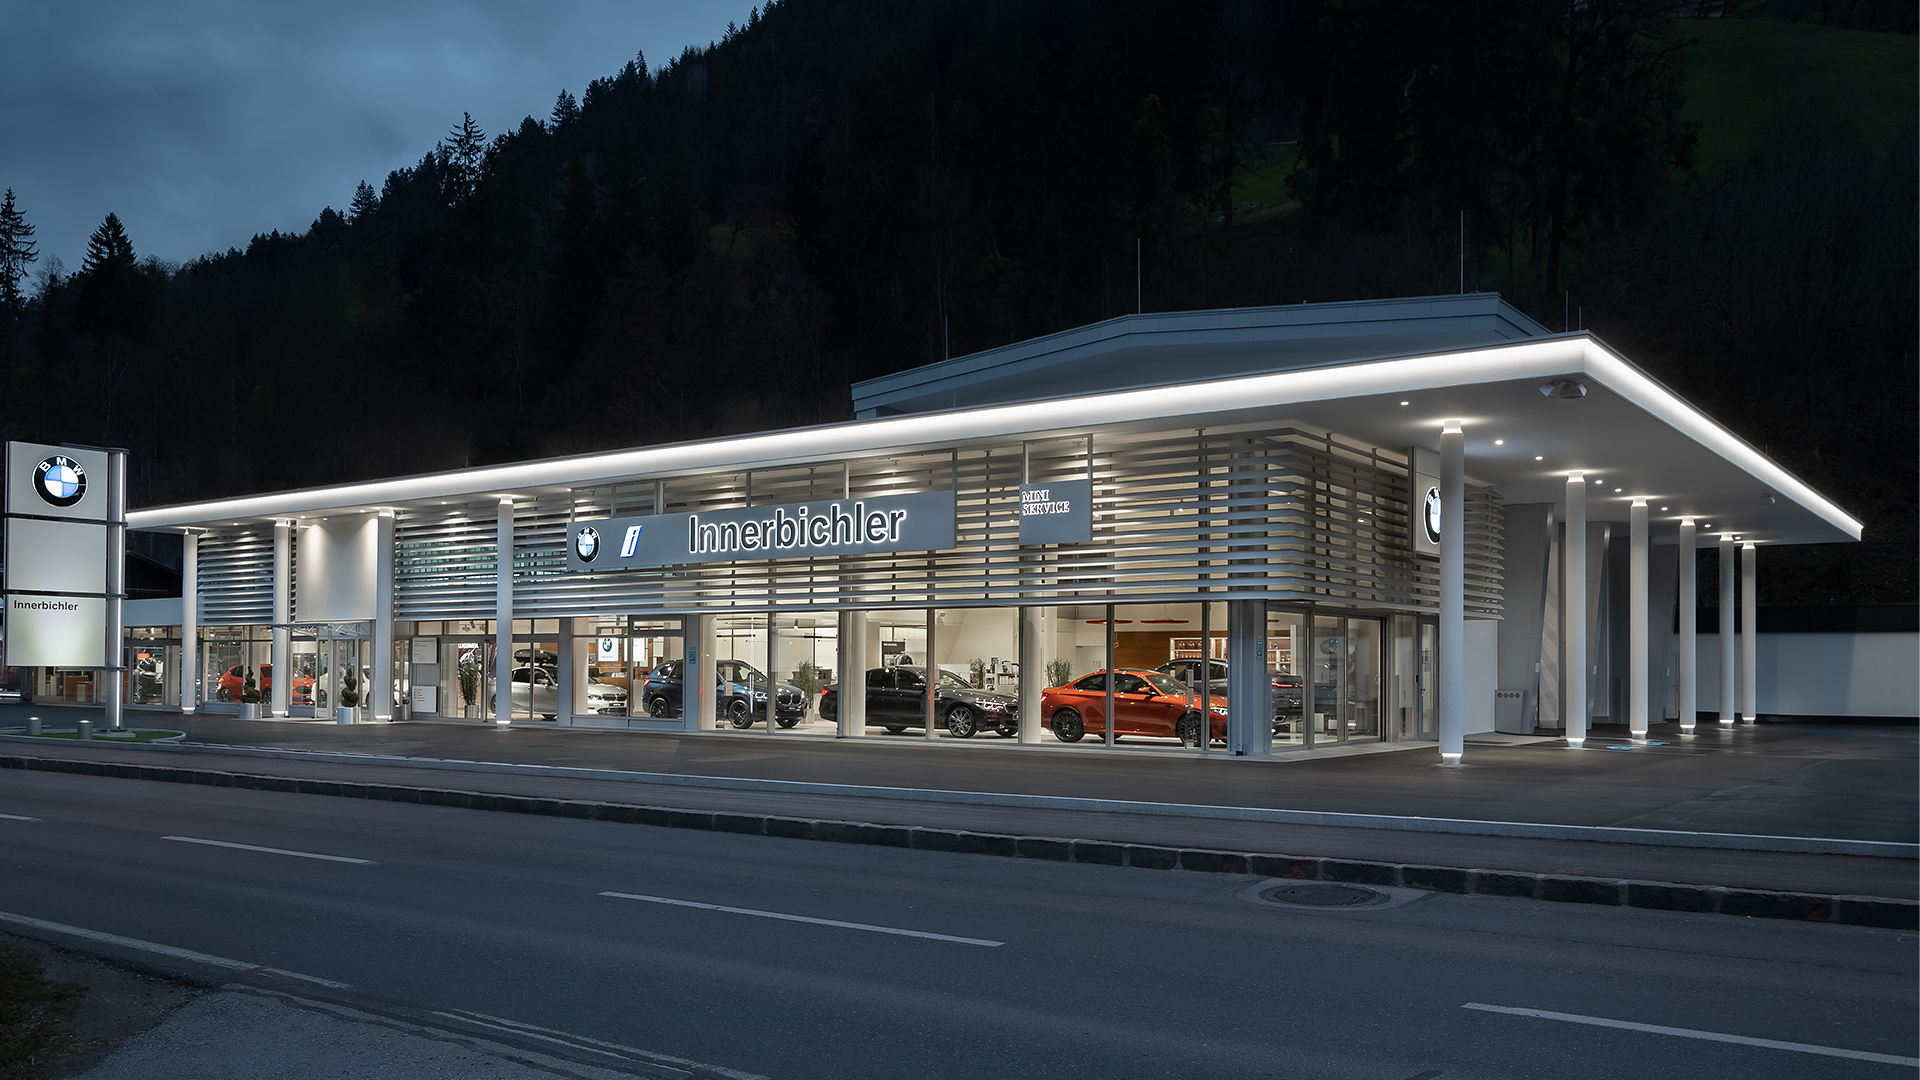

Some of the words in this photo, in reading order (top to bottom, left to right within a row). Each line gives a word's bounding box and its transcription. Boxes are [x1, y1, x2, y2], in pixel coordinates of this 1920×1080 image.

[39, 457, 84, 476] BMW
[1022, 489, 1050, 502] MINI
[1022, 501, 1069, 515] SERVICE
[577, 527, 597, 540] BMW
[689, 503, 906, 553] Innerbichler
[14, 599, 79, 612] Innerbichler
